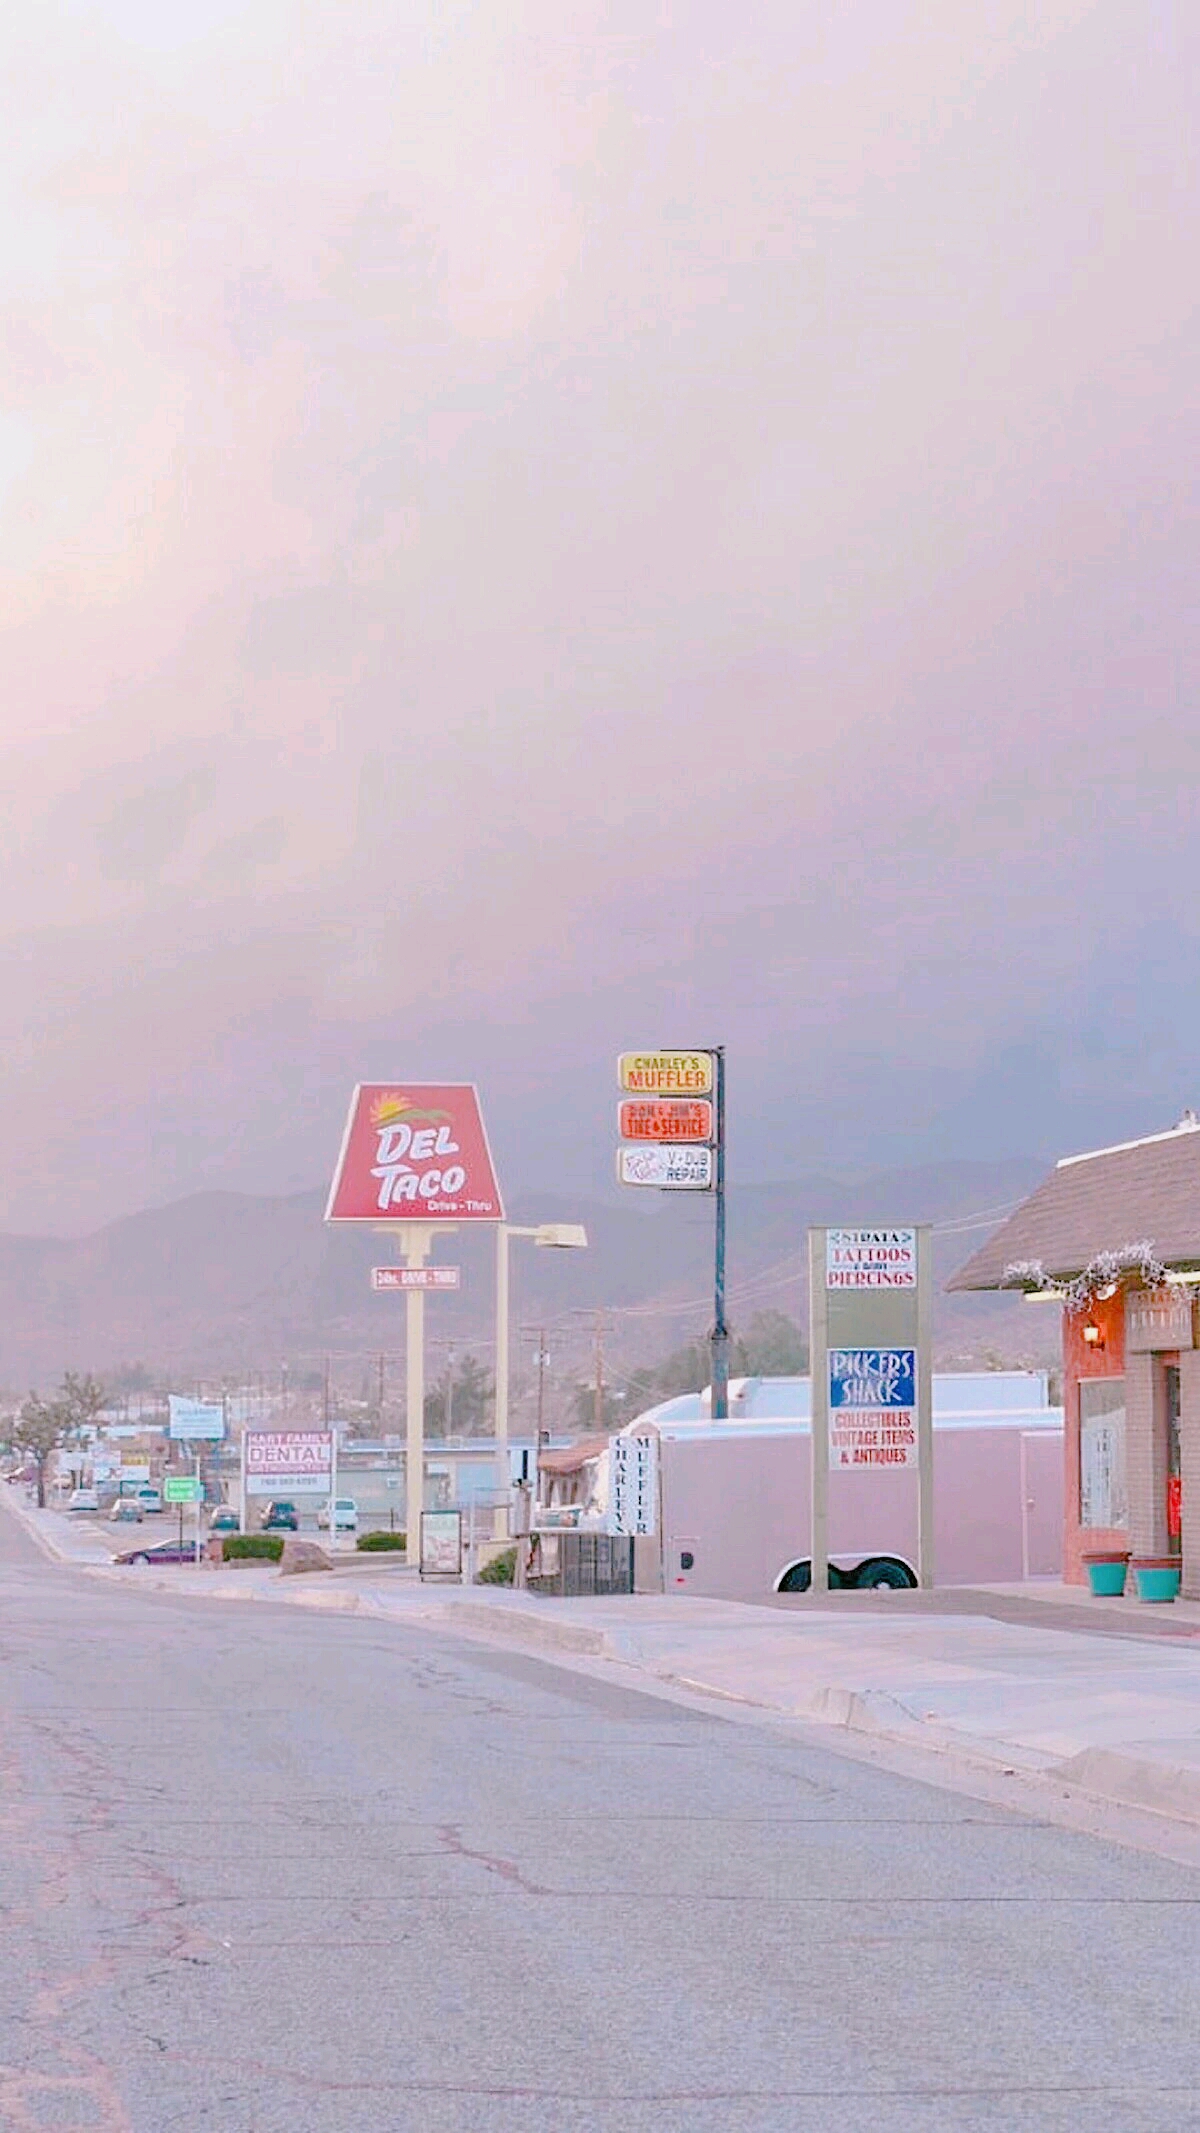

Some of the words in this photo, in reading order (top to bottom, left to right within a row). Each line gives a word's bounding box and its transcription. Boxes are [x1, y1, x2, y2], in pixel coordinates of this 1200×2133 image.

[635, 1058, 699, 1069] CHARLEY'S
[628, 1070, 706, 1087] MUFFLER
[376, 1123, 460, 1164] DEL
[667, 1167, 708, 1181] REPAIR
[370, 1164, 466, 1210] TACO
[427, 1201, 457, 1211] Drive
[465, 1201, 492, 1211] Thru
[842, 1232, 899, 1242] STRATA
[832, 1248, 911, 1262] TATTOOS
[828, 1271, 914, 1285] PIERCINGS
[831, 1352, 912, 1378] PICKERS
[841, 1380, 902, 1404] SHACK
[835, 1411, 911, 1428] COLLECTIBLES
[831, 1430, 878, 1446] VINTAGE
[881, 1429, 915, 1446] ITEMS
[250, 1446, 328, 1462] DENTAL
[853, 1448, 906, 1464] ANTIQUES
[636, 1438, 649, 1533] MUFFLER
